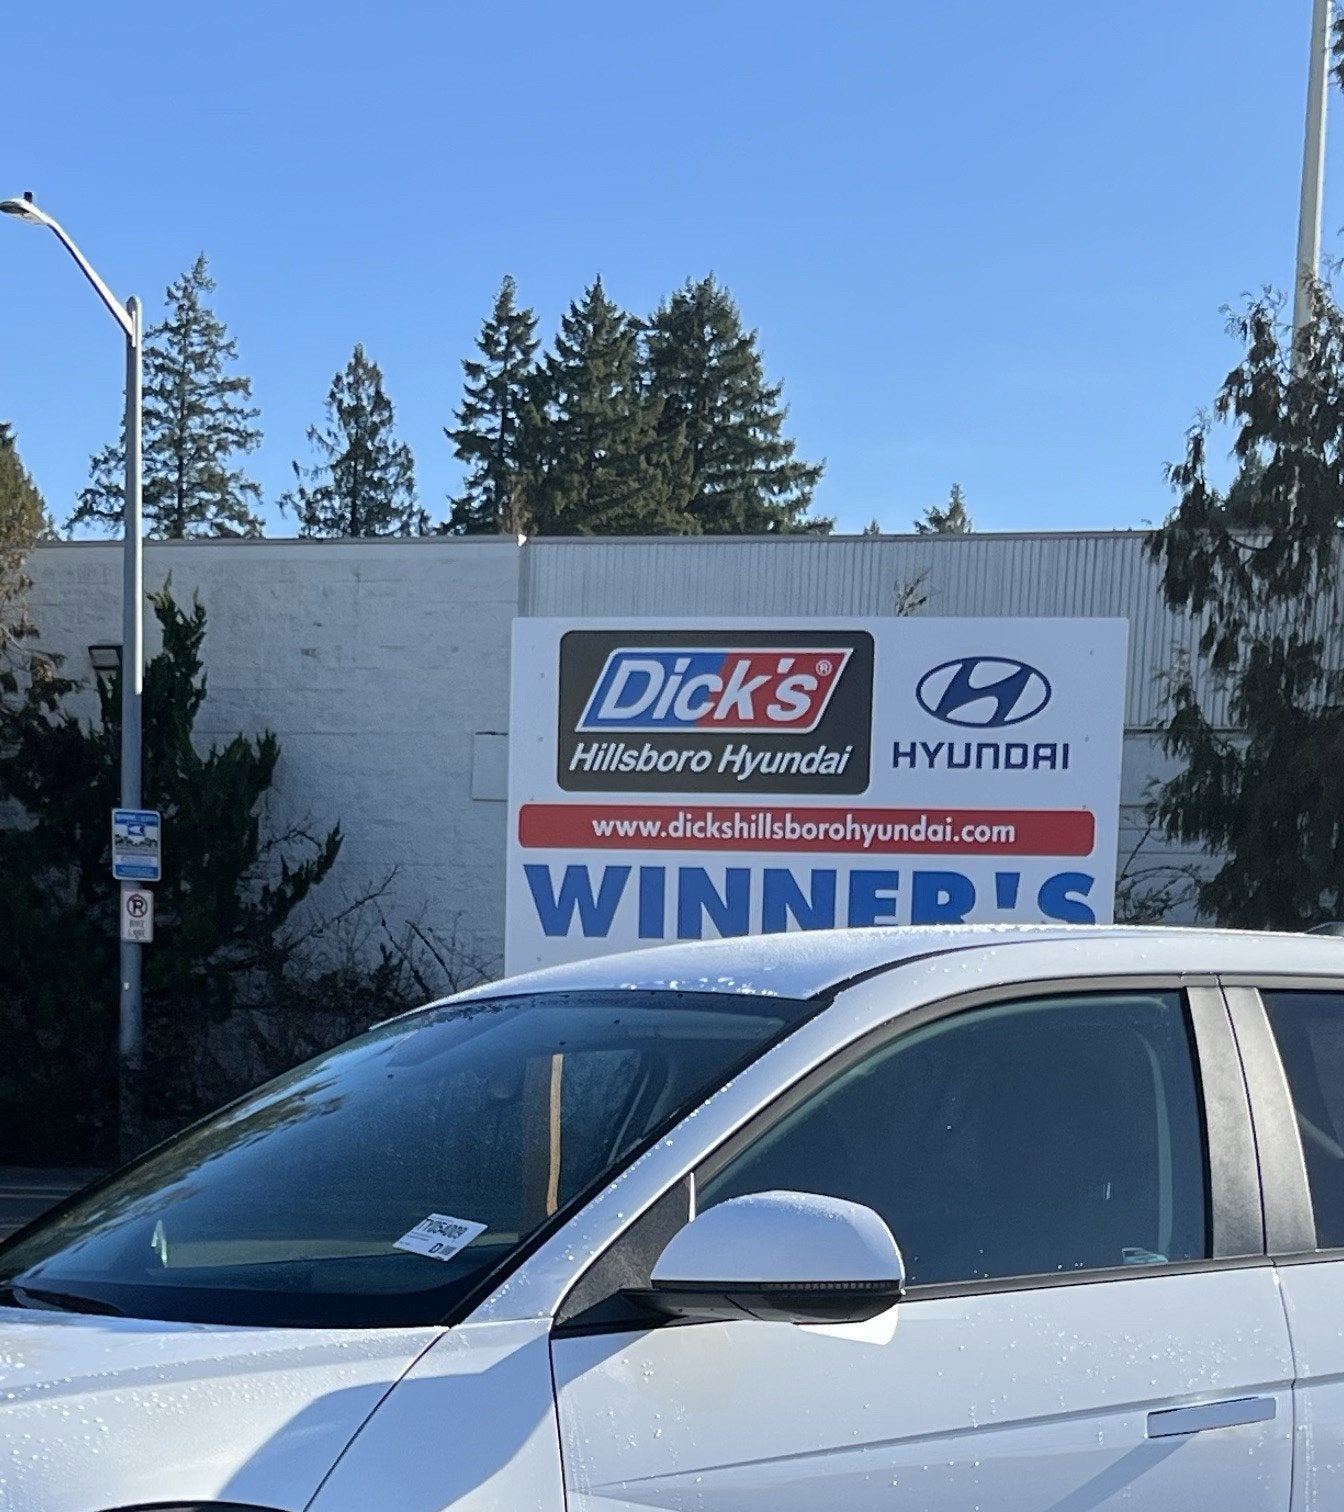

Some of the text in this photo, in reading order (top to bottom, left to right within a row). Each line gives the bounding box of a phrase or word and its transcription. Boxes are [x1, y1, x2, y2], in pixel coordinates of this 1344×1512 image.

[568, 742, 854, 782] Hillsboro Hyundai
[892, 741, 1071, 771] HYUNDAI
[591, 811, 1017, 849] www.dickshillsborohyundai.com
[523, 864, 1097, 939] WINNER'S
